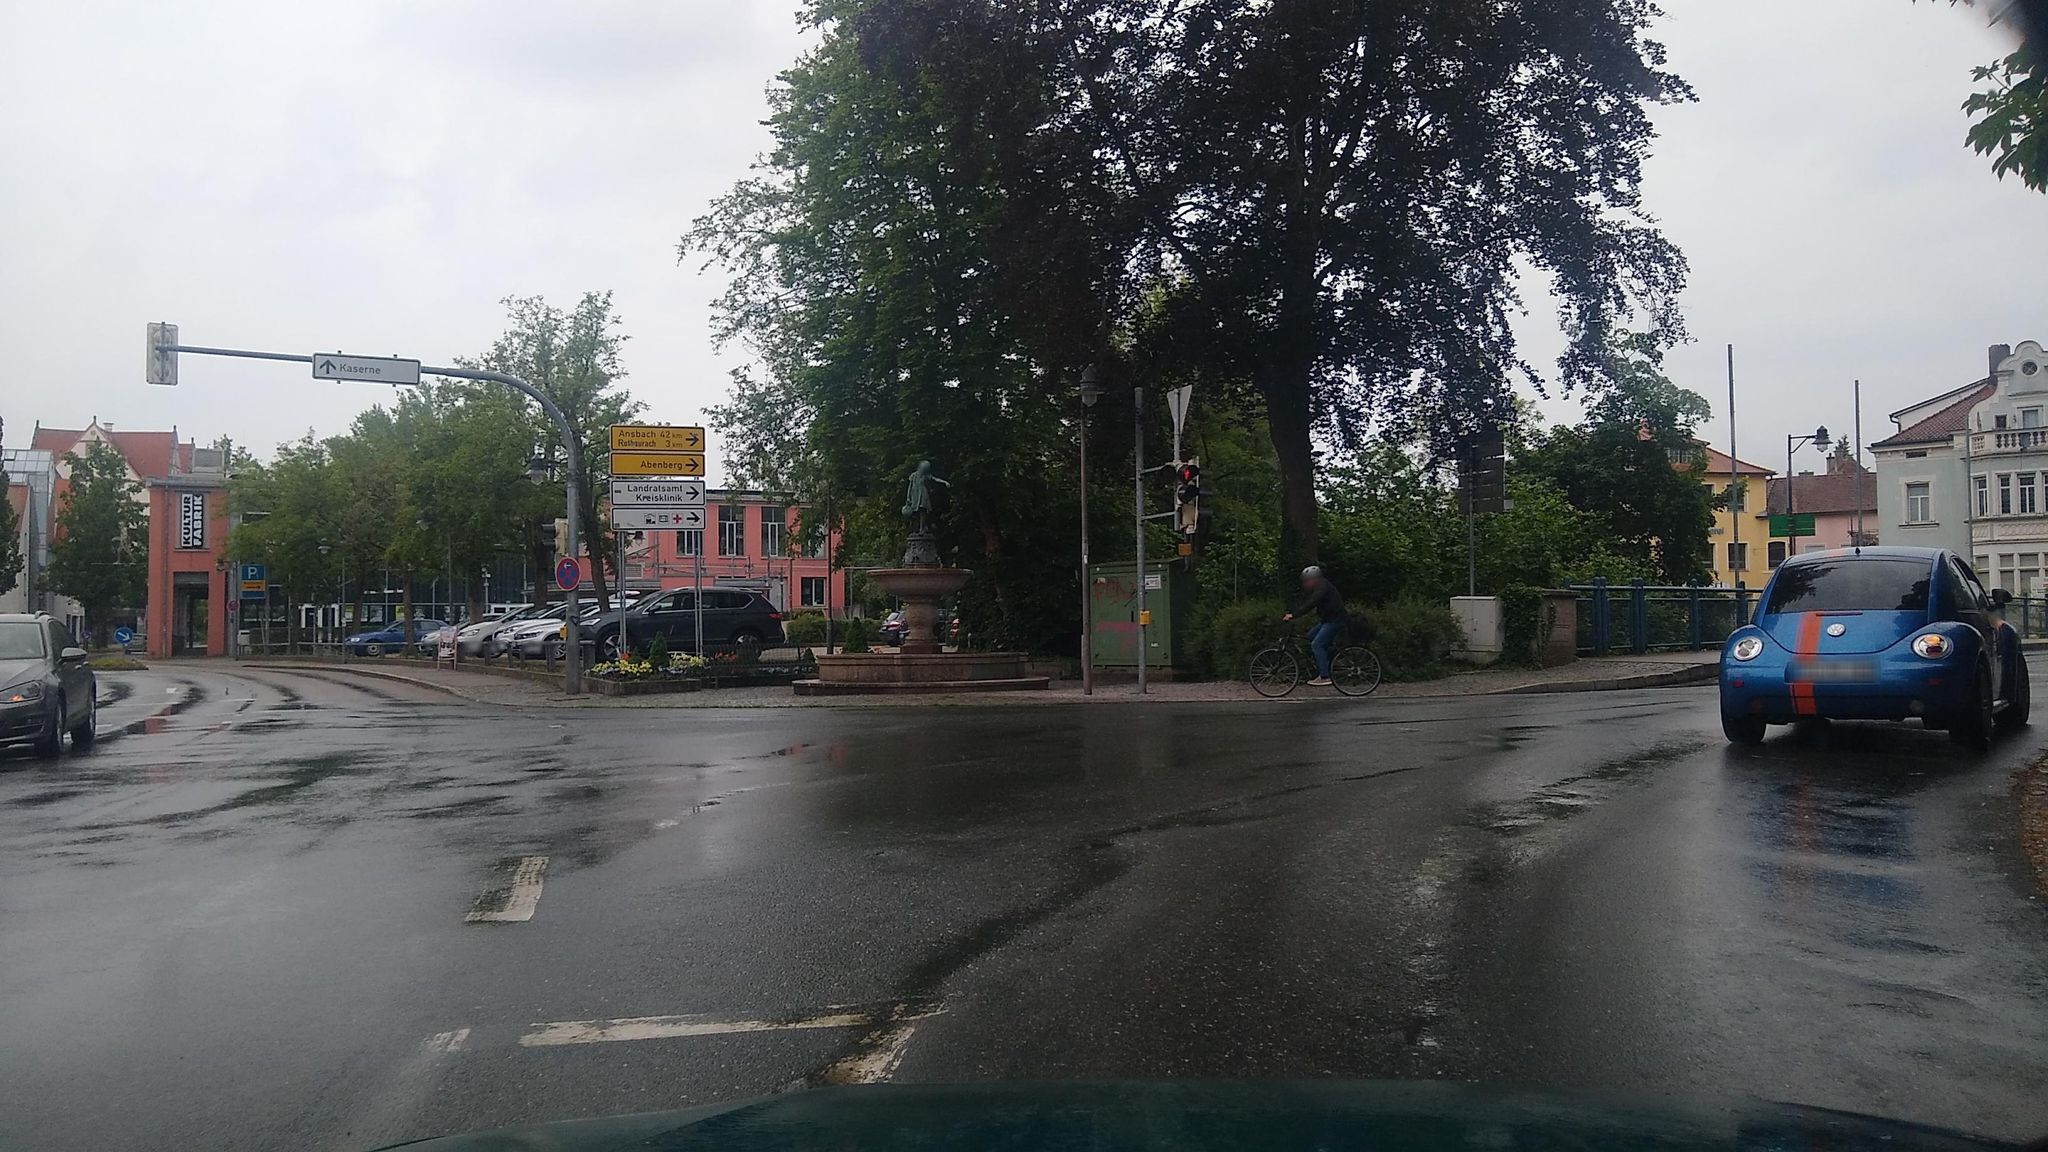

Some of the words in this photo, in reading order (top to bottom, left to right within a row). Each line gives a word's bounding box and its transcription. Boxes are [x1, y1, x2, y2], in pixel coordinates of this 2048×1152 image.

[340, 363, 381, 375] Kaserne
[619, 430, 656, 438] Ansbach
[660, 431, 671, 439] 42
[666, 440, 671, 448] 3
[641, 461, 683, 471] Abenberg
[627, 484, 683, 492] Landratsamt
[636, 494, 683, 502] Kreisklinik
[183, 496, 191, 545] KULTUR
[193, 495, 203, 546] FABRIK
[248, 567, 257, 579] P
